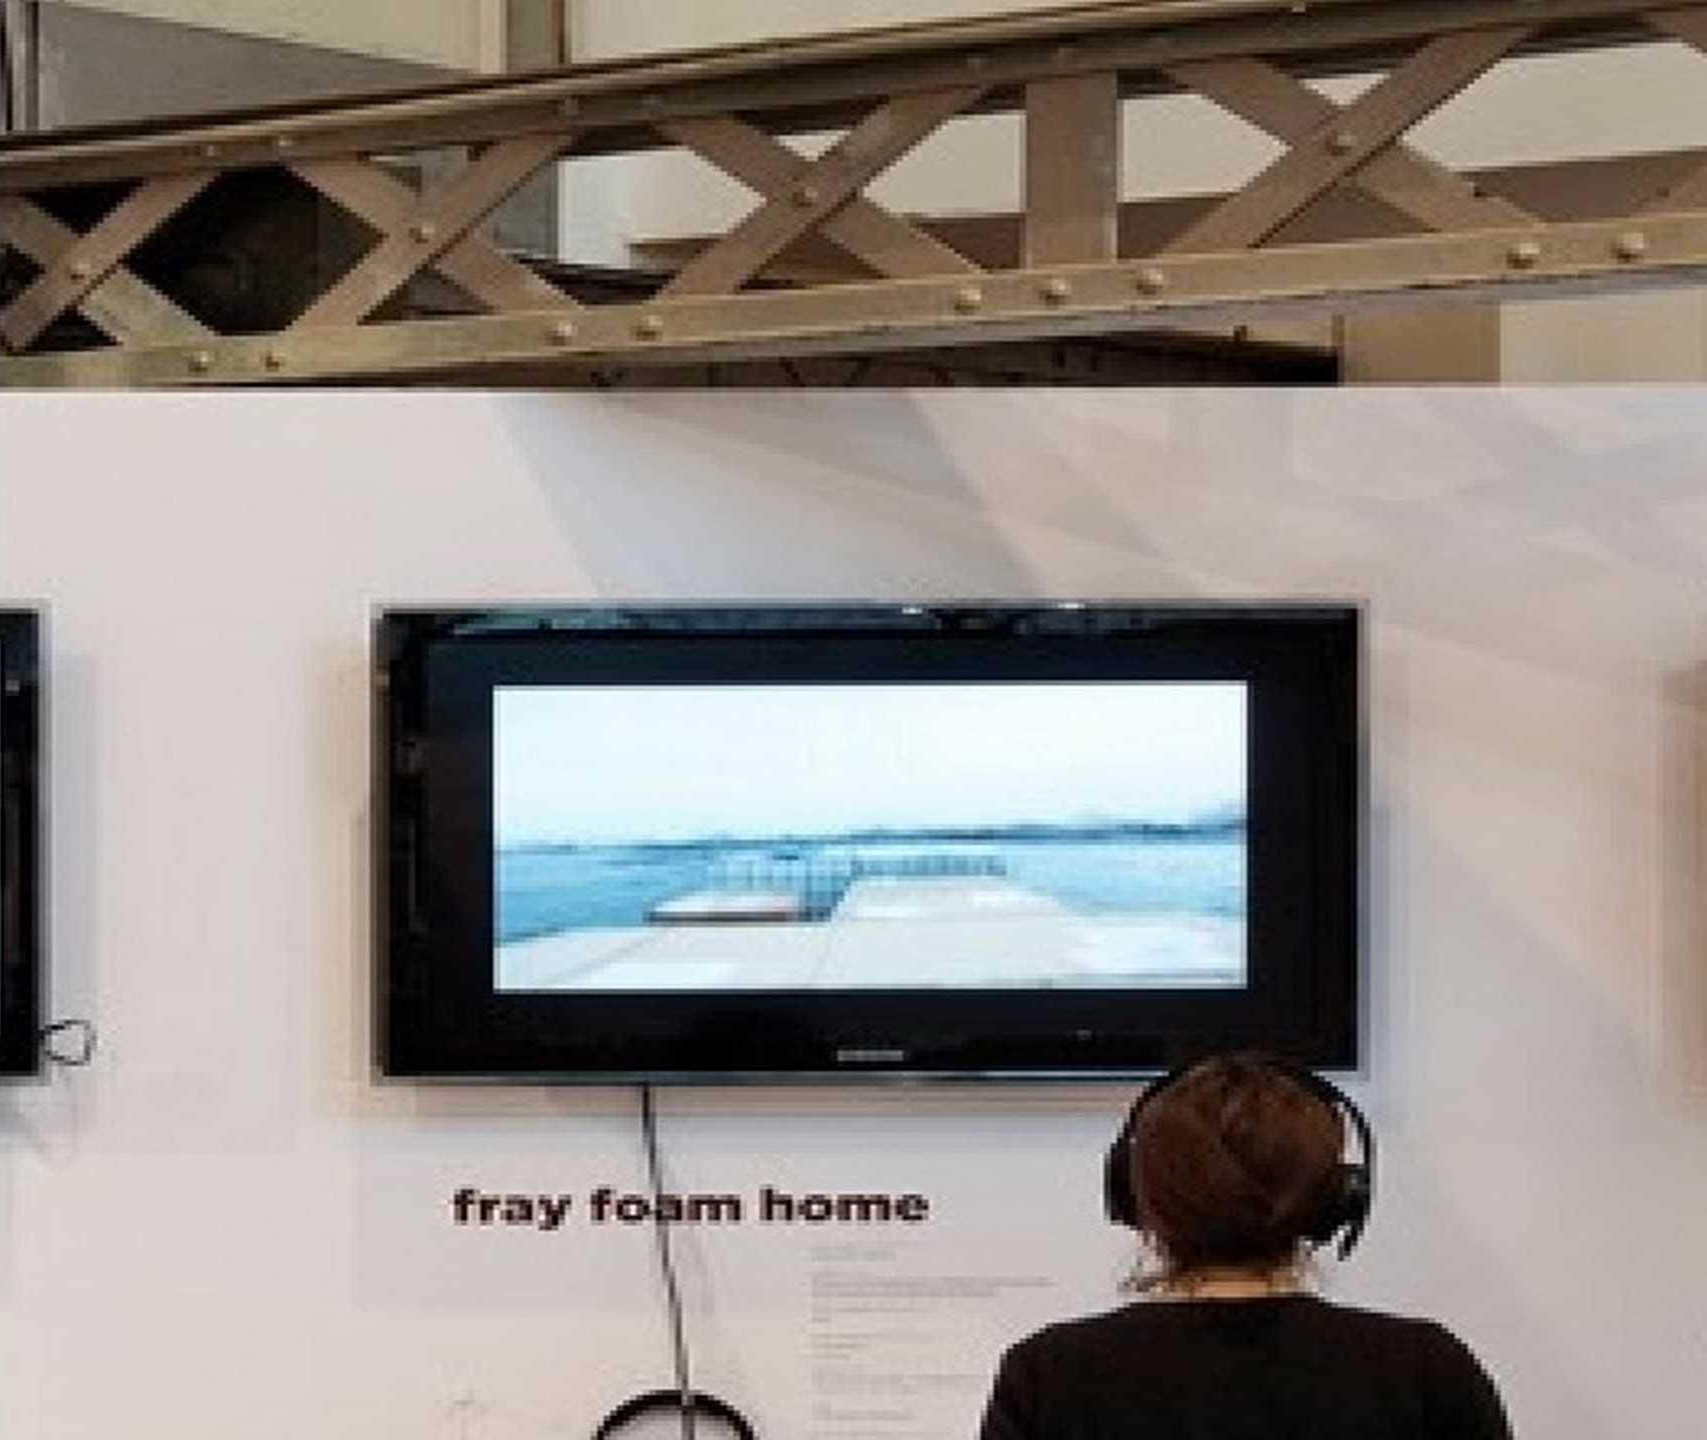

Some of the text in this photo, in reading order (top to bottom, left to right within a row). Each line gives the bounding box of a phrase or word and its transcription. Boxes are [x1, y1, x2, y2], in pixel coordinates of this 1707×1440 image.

[454, 1185, 929, 1231] fray foam home
